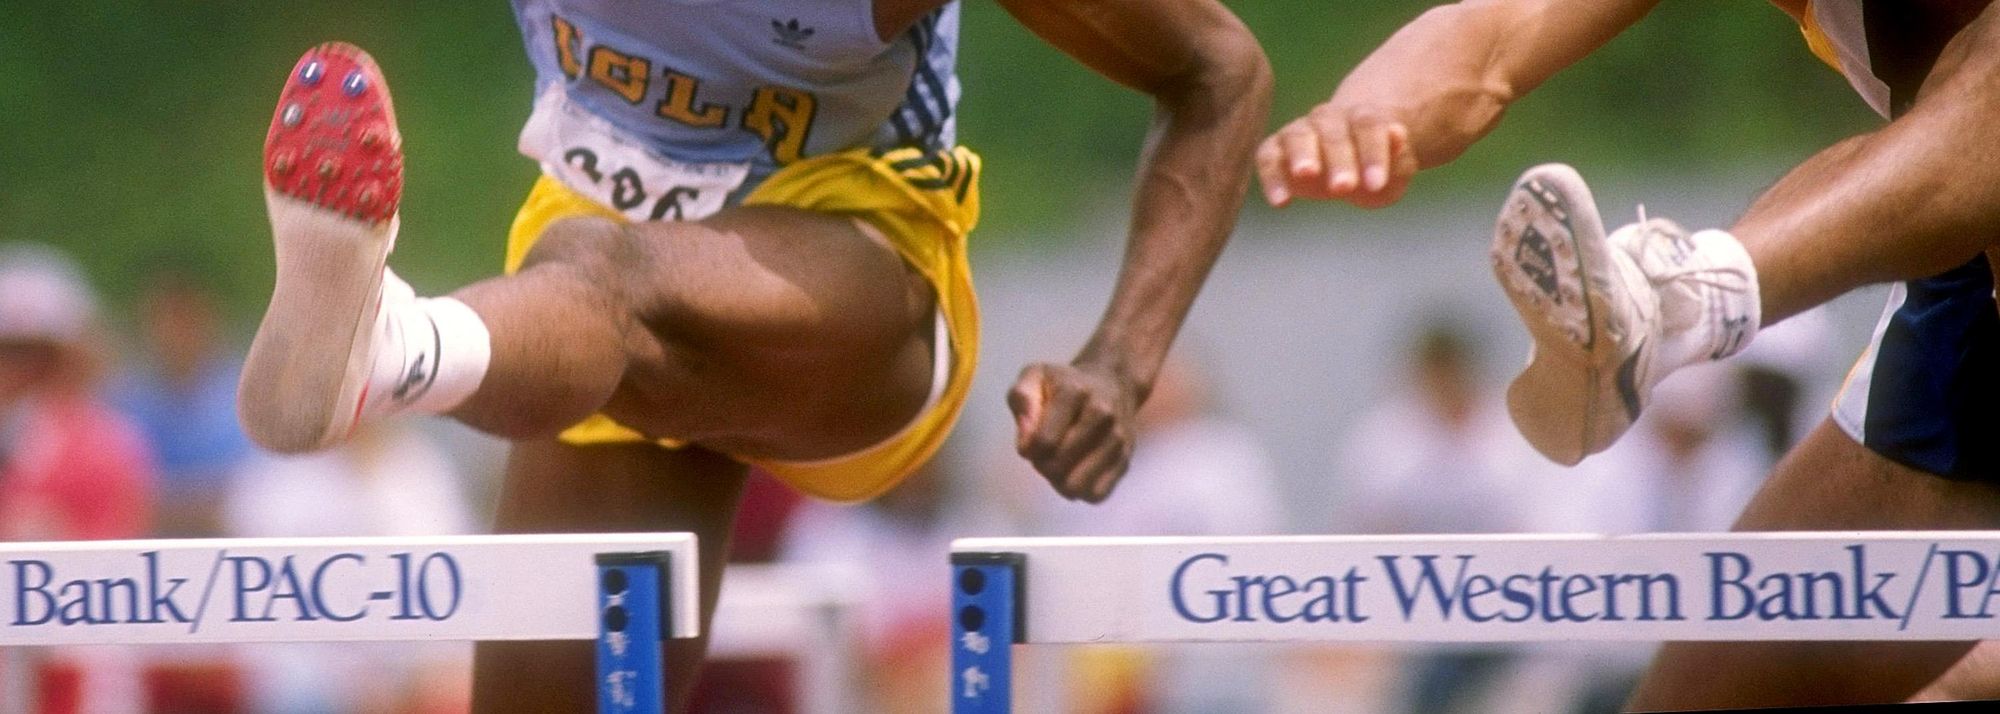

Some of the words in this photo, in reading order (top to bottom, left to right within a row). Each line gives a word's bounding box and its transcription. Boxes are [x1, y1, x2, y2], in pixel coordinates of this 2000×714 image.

[9, 550, 462, 633] Bank/PAC-10
[1169, 552, 1369, 624] Great
[1376, 554, 1687, 623] Western
